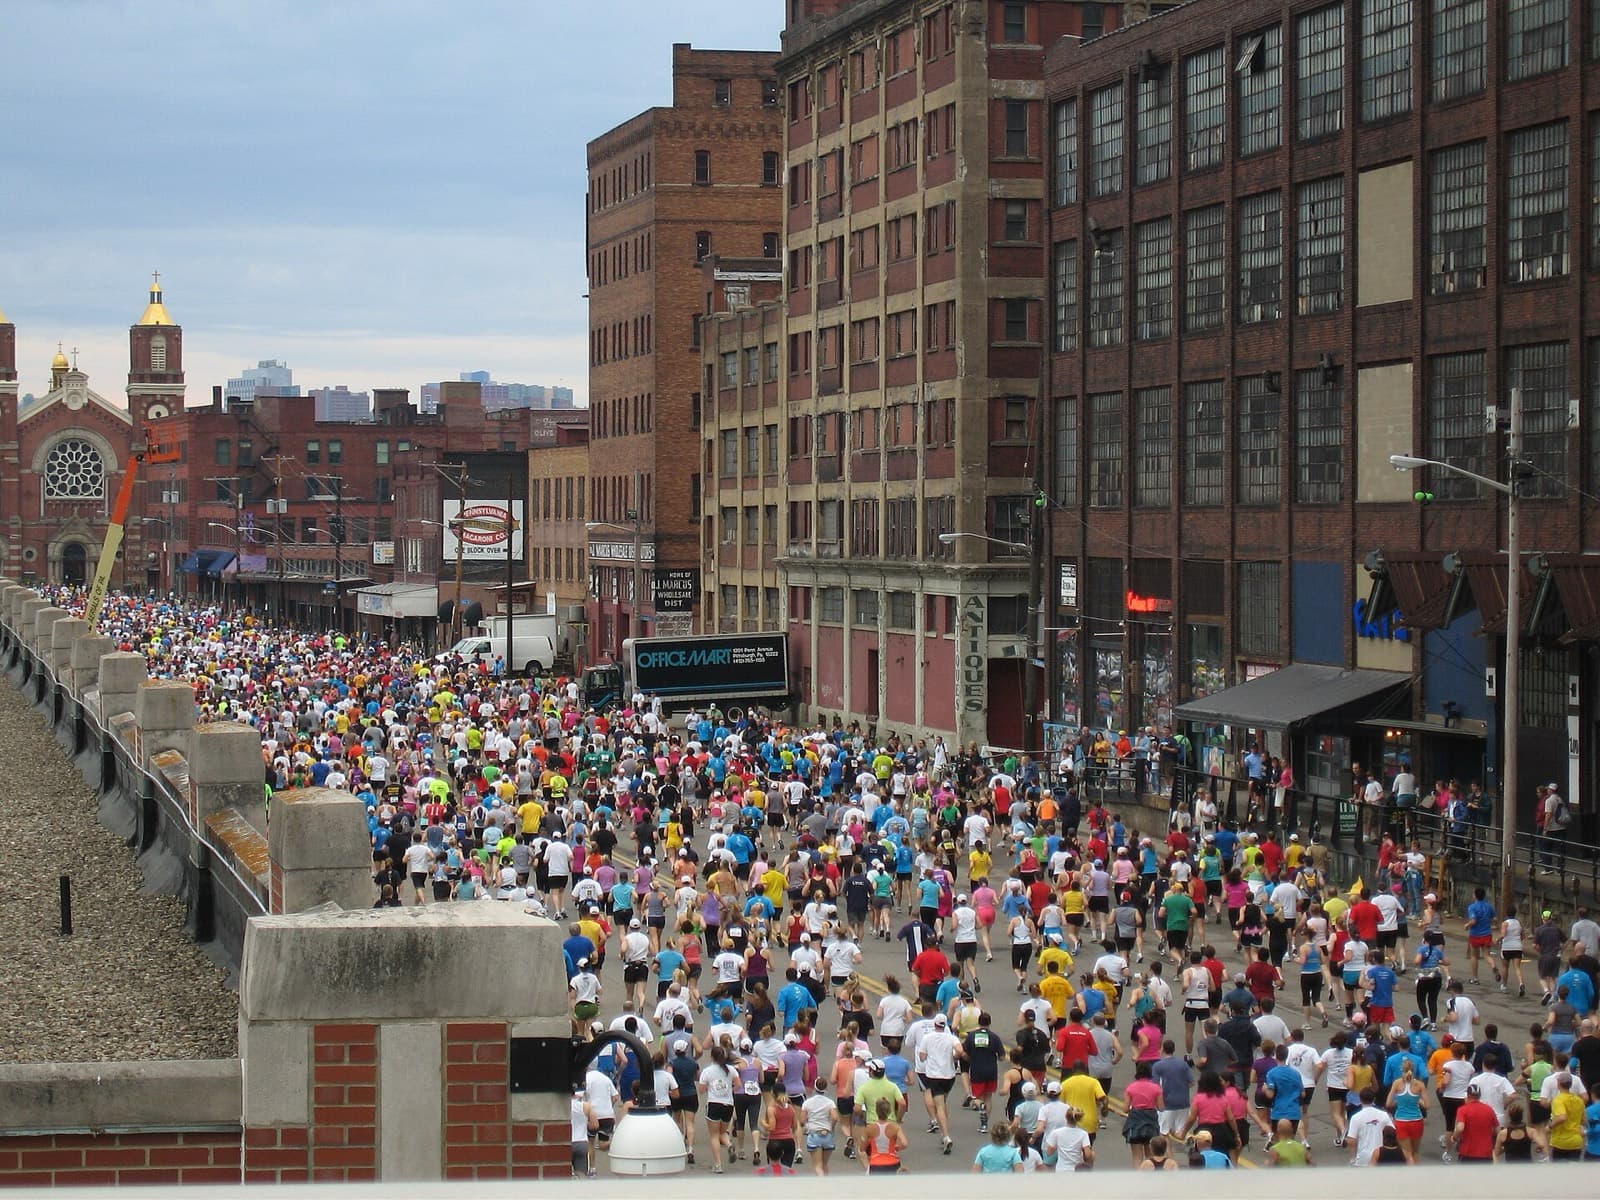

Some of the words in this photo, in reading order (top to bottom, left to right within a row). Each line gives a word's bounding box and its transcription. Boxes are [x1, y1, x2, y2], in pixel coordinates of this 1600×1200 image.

[662, 579, 692, 590] MARCUS
[657, 591, 692, 599] WHOLESALE
[964, 595, 985, 712] ANTIQUES
